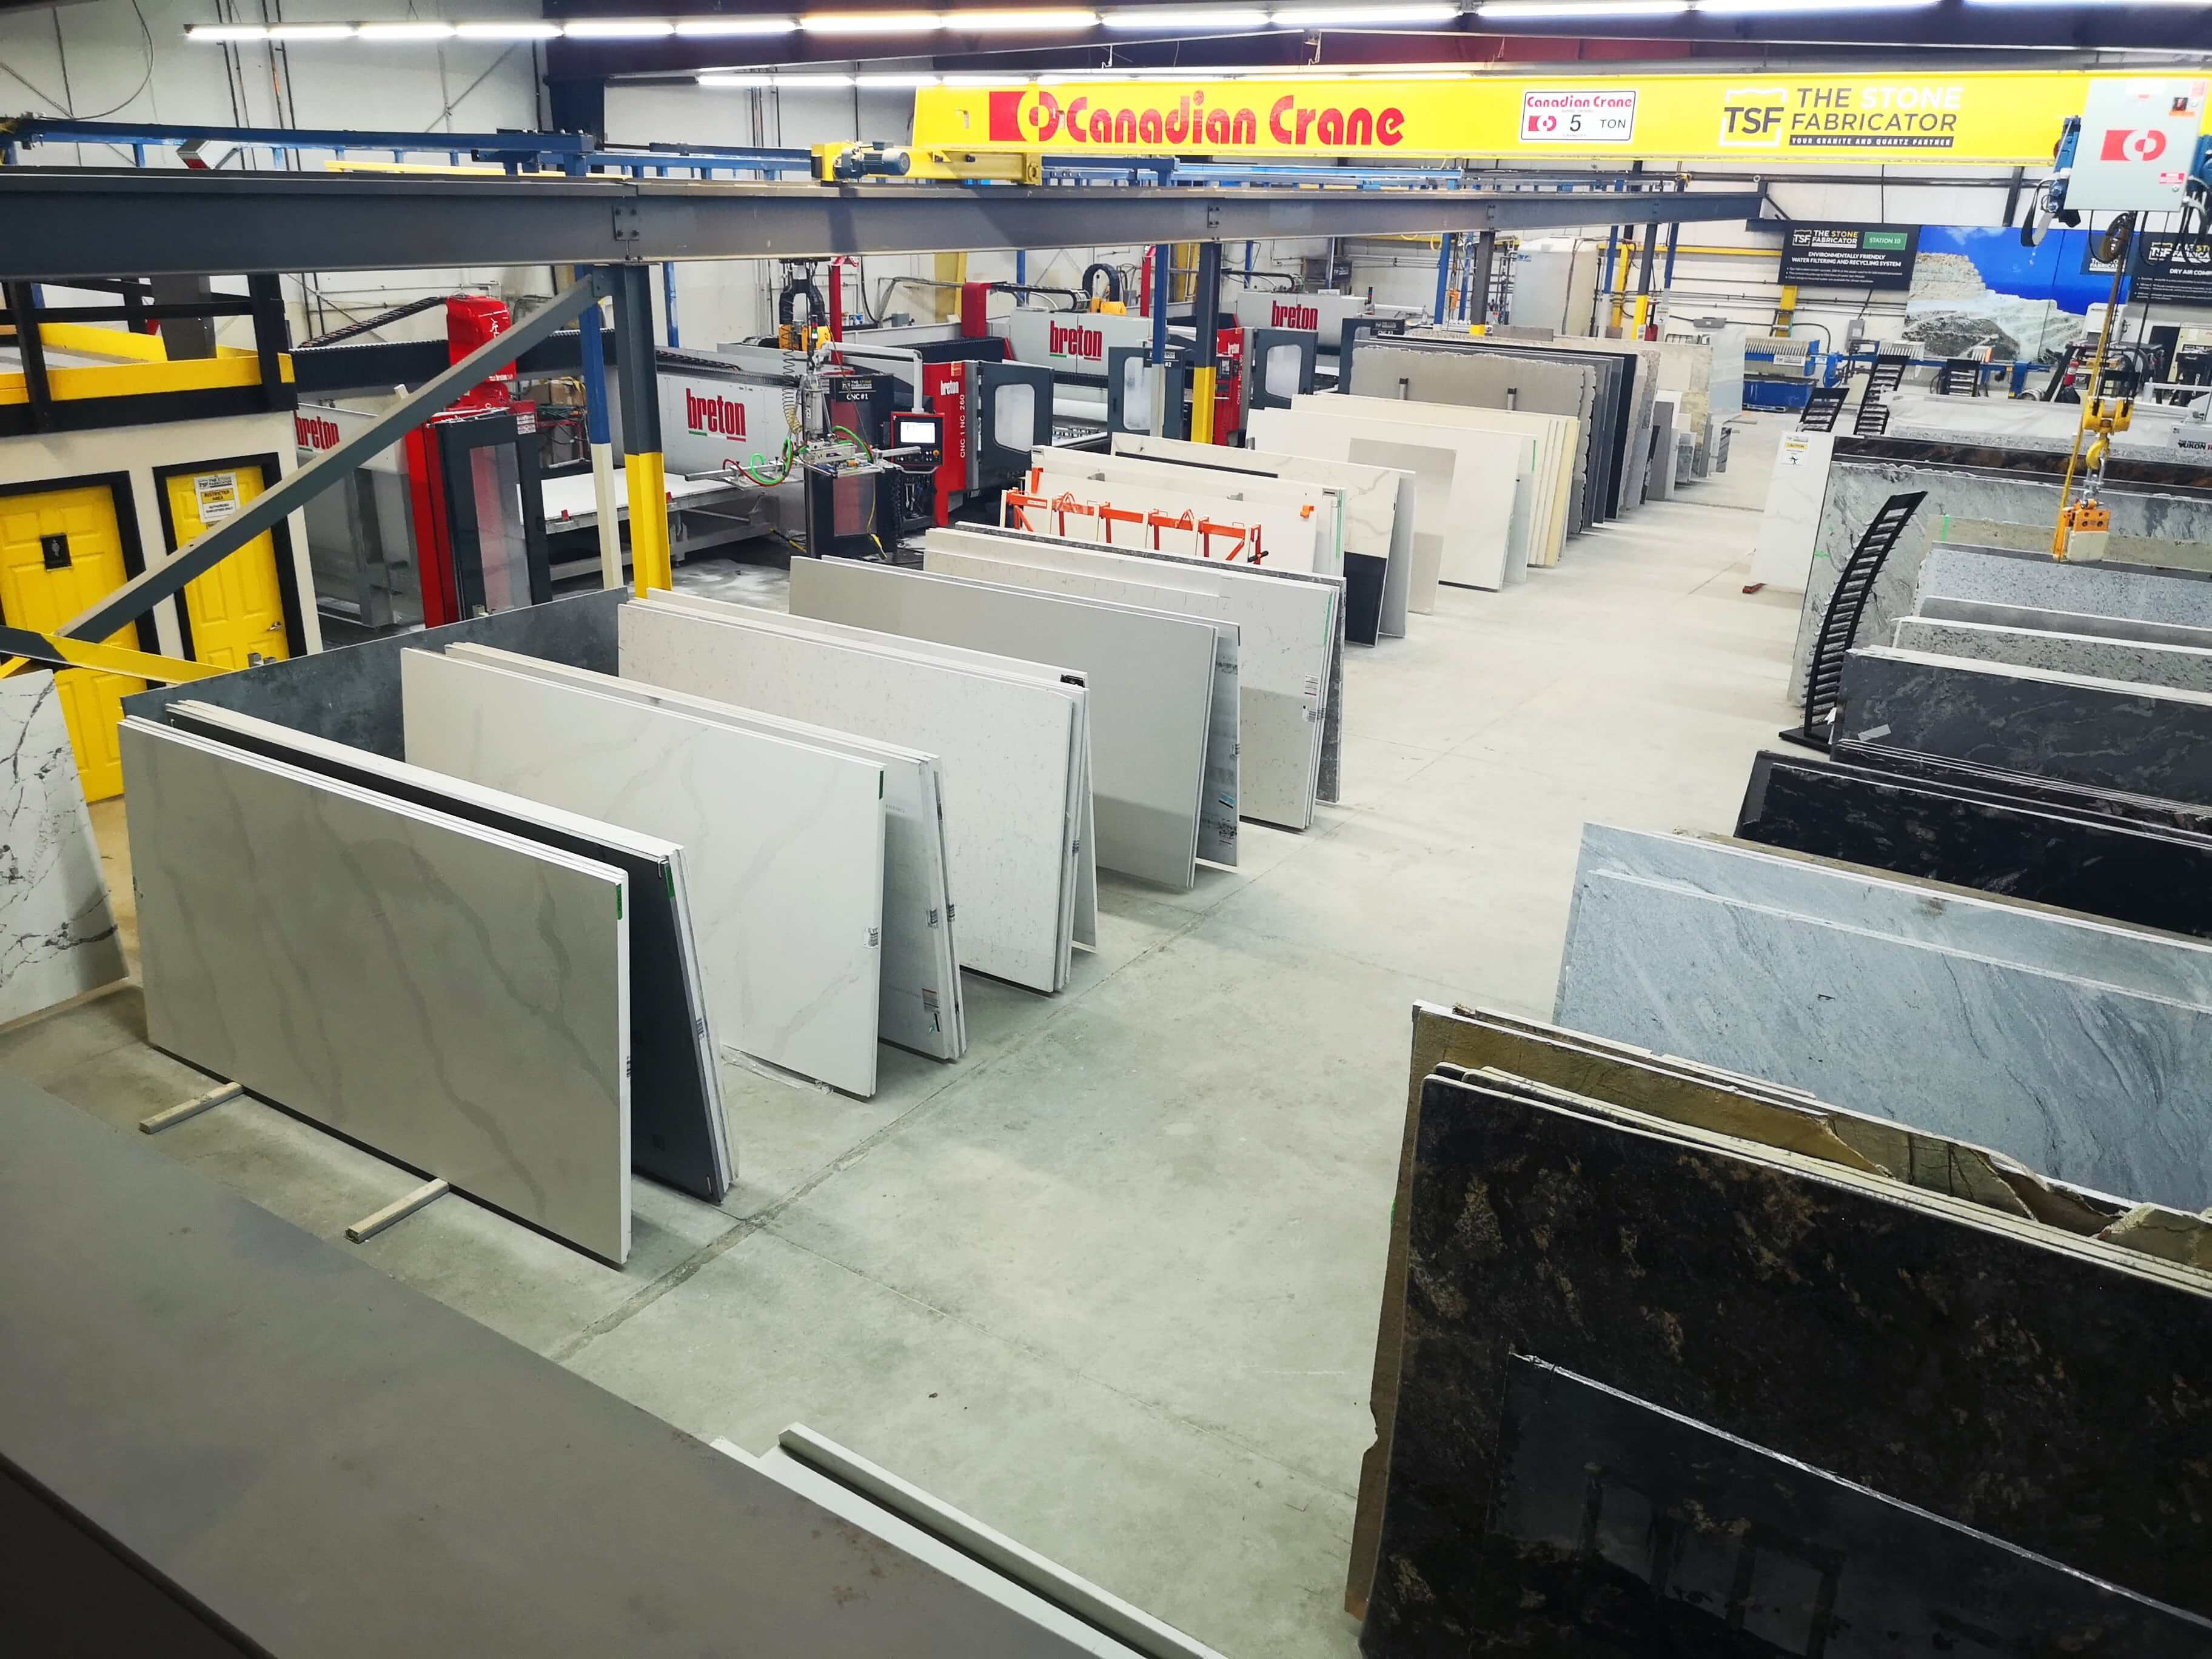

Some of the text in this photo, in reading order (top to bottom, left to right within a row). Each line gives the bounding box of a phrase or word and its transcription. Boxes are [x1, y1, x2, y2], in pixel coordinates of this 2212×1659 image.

[1527, 95, 1632, 107] Canadian Crane
[1797, 87, 1963, 110] THE STONE
[1067, 90, 1405, 146] Canadian Crane
[1569, 115, 1626, 132] 5 TON
[1724, 107, 1784, 134] TSF
[1791, 113, 1957, 132] FABRICATOR
[1793, 234, 1811, 243] TSF
[1271, 300, 1318, 330] breton
[1050, 320, 1102, 357] breton
[940, 380, 959, 395] breton
[685, 387, 746, 437] breton
[960, 415, 965, 428] NC
[294, 411, 340, 449] breton
